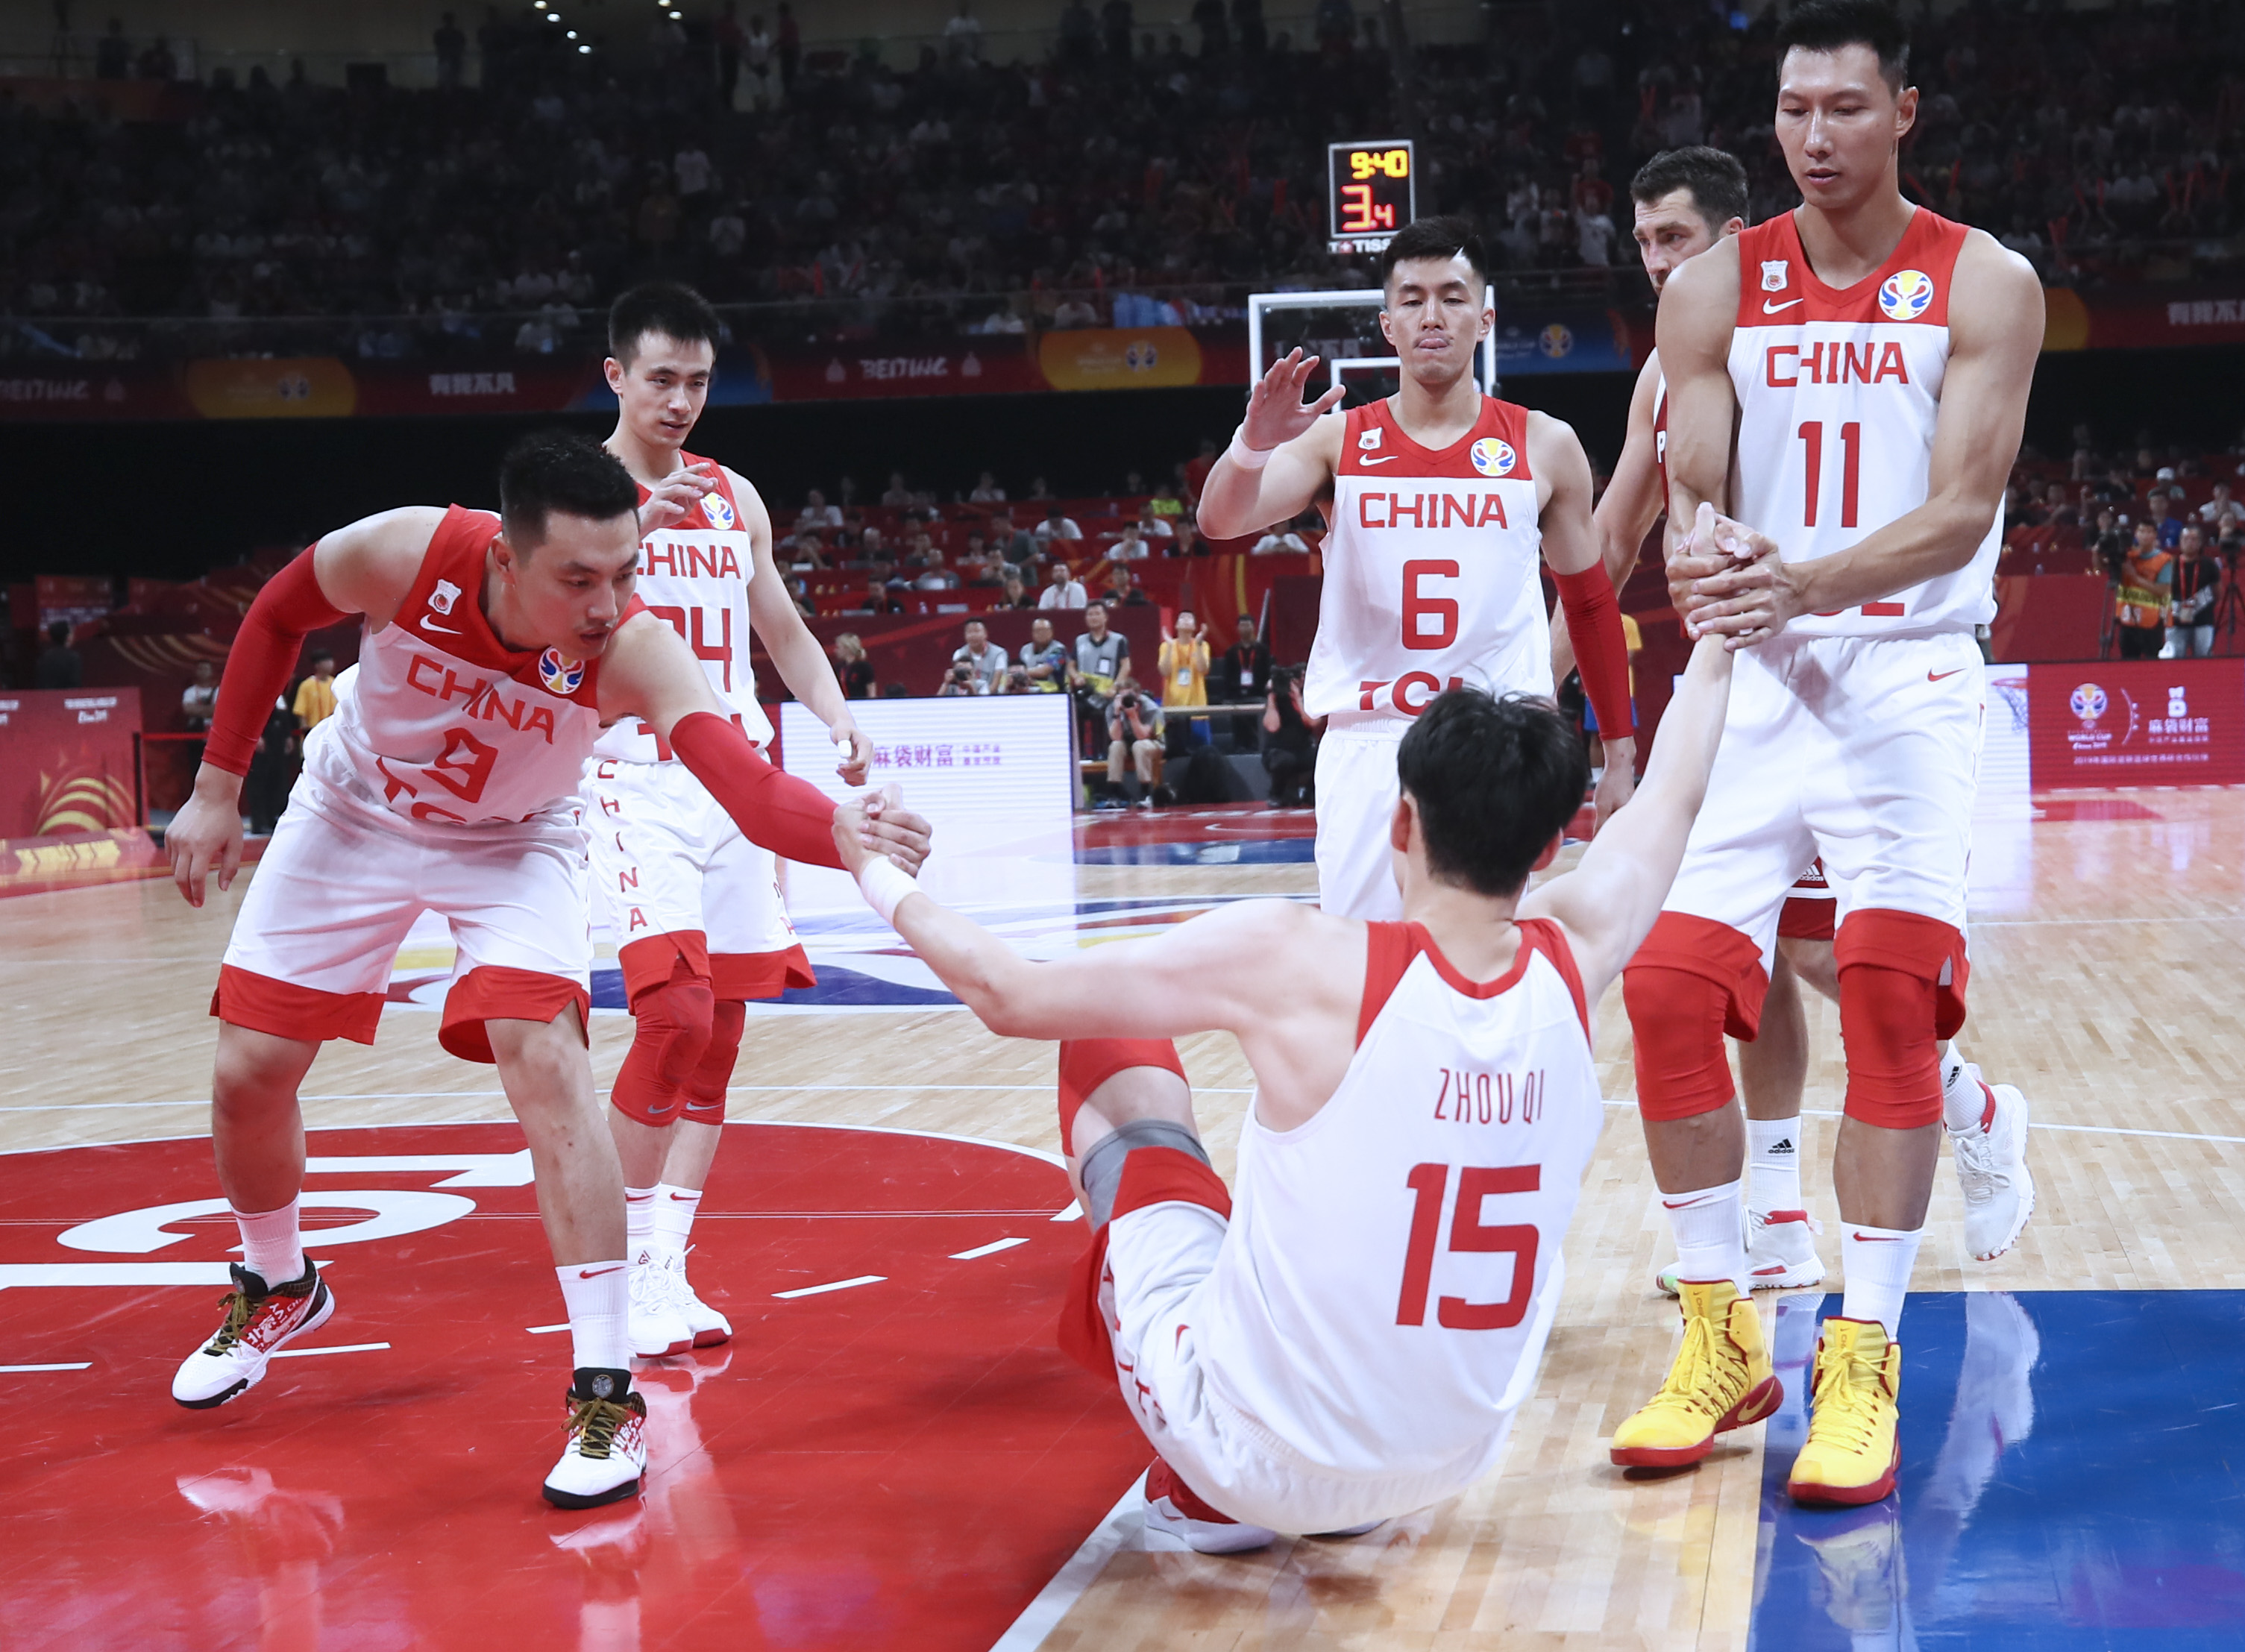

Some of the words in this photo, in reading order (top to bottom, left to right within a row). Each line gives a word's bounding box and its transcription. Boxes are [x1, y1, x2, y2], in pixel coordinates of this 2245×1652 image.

[1351, 150, 1408, 179] 9:40
[1342, 184, 1394, 231] 3.4
[1766, 342, 1909, 387] CHINA
[1797, 421, 1860, 528] 11
[1359, 493, 1508, 530] CHINA
[1401, 559, 1460, 650] 6
[406, 654, 553, 745] CHINA
[1357, 670, 1463, 716] TC
[421, 727, 499, 804] 9
[874, 744, 953, 768] 麻袋财富
[597, 759, 648, 932] CHINA
[1434, 1068, 1513, 1124] ZHOU
[1523, 1069, 1545, 1125] QI
[1395, 1162, 1542, 1331] 15
